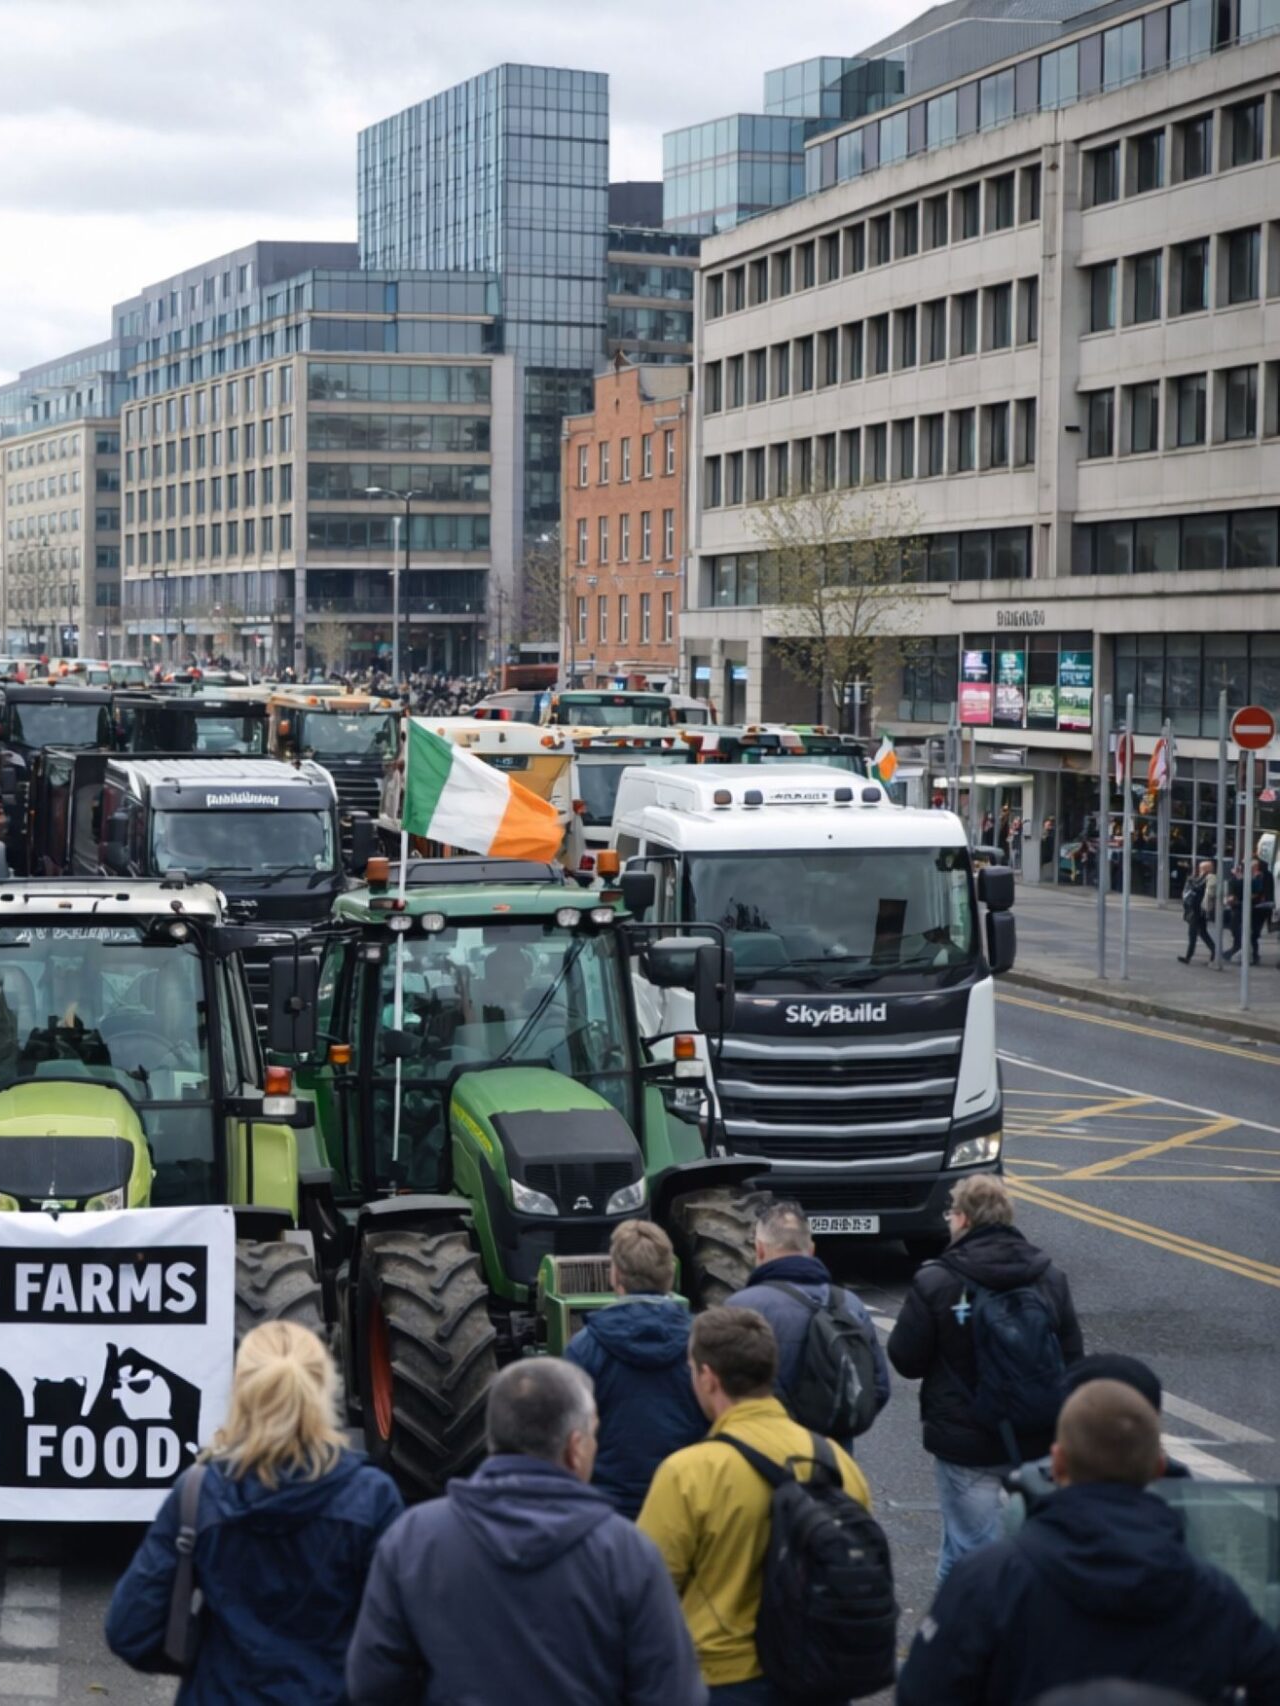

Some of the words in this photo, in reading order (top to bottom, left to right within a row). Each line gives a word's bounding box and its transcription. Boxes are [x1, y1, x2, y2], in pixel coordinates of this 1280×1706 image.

[785, 1003, 887, 1028] SkyBuild
[15, 1262, 198, 1313] FARMS
[26, 1425, 181, 1479] FOOD
